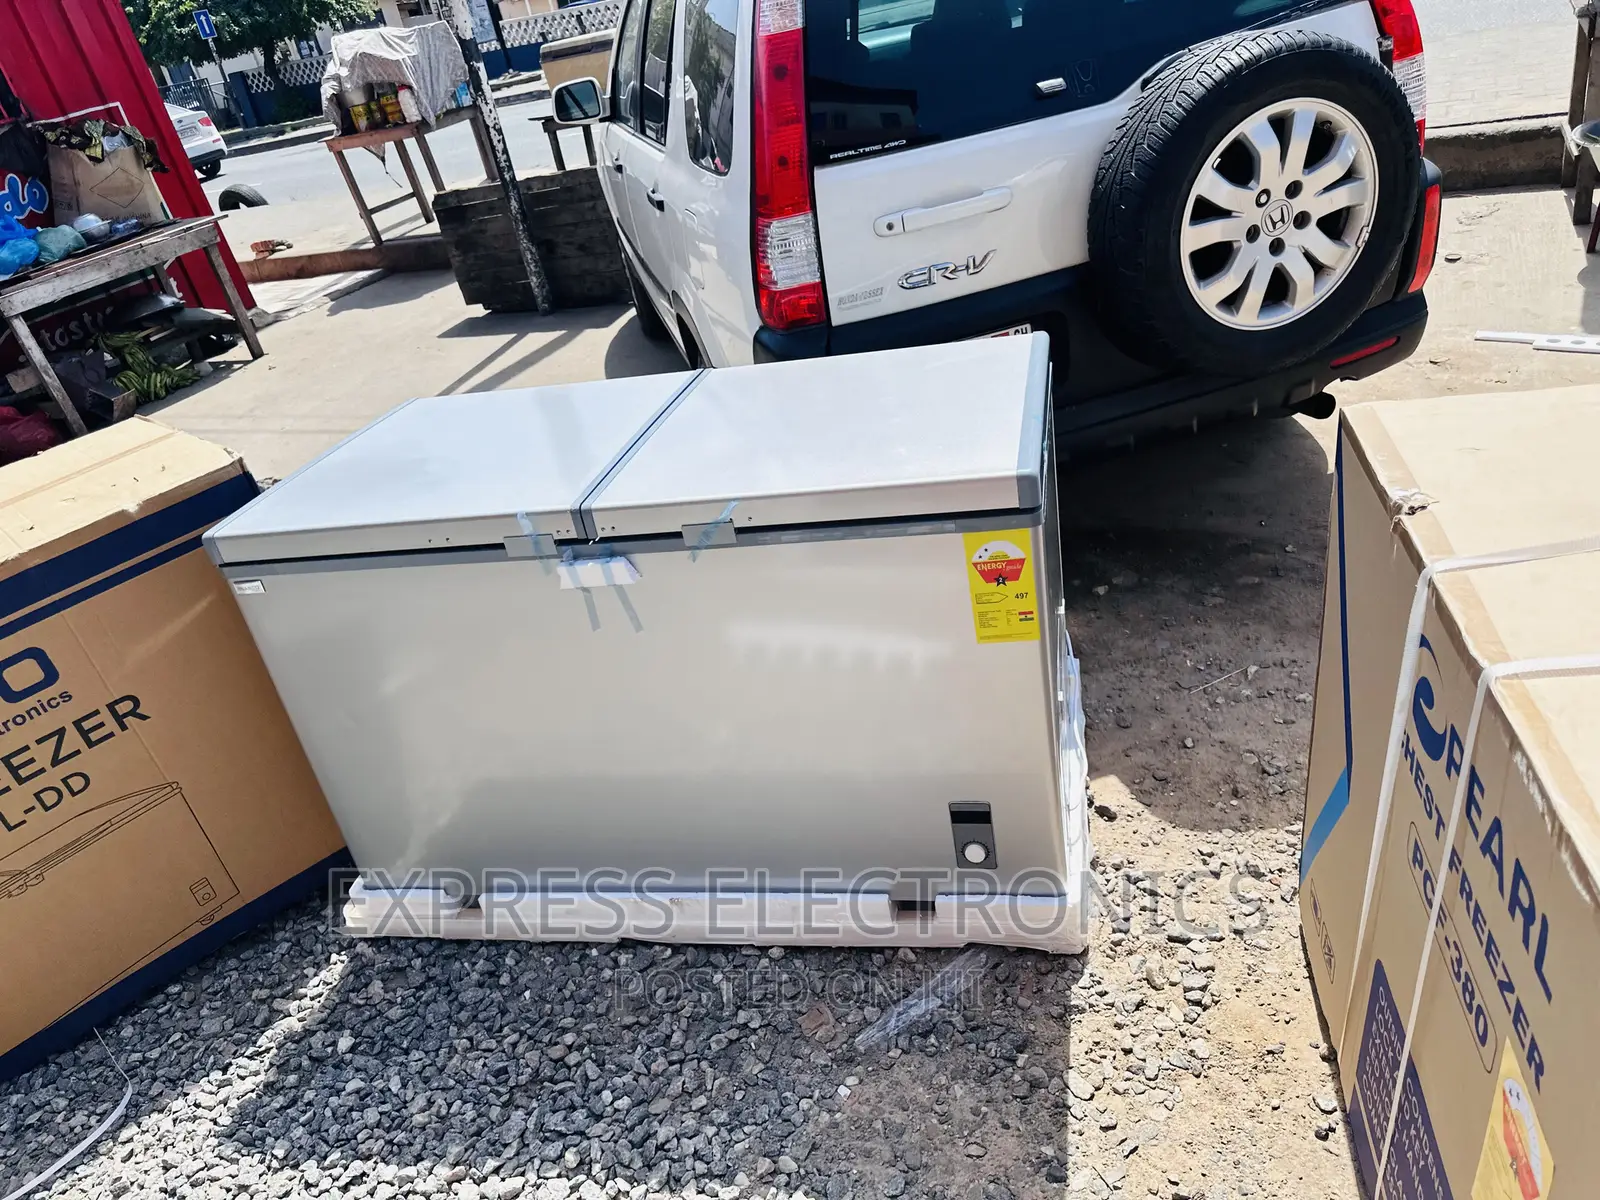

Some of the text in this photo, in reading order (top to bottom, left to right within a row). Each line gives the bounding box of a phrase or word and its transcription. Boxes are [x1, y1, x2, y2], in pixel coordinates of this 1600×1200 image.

[830, 144, 882, 159] REALTIME
[897, 248, 998, 290] CR-V
[976, 562, 1007, 572] ENERGY
[1014, 592, 1028, 600] 497
[1445, 723, 1553, 1005] PEARL
[1401, 730, 1446, 842] HEST
[1448, 844, 1546, 1096] FREEZER
[1379, 986, 1403, 1061] OUTSID
